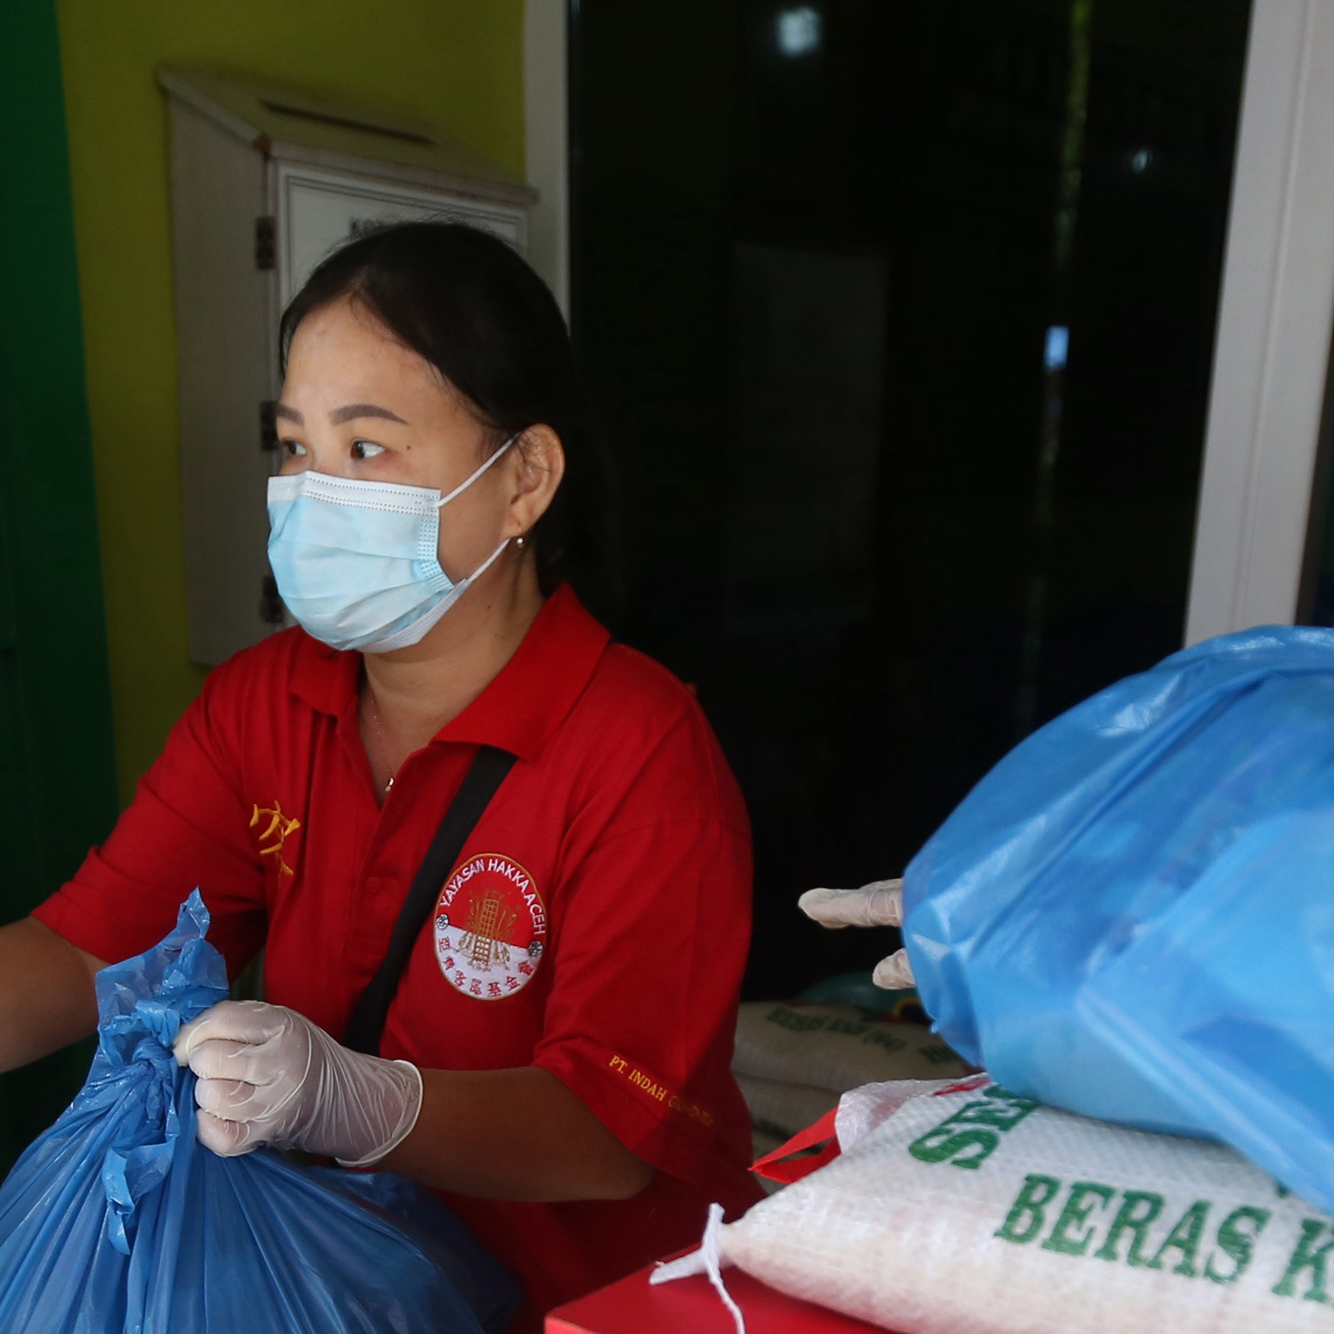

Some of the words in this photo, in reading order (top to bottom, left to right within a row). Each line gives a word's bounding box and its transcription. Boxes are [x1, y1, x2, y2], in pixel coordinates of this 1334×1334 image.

[439, 858, 485, 907] YAYASAN
[487, 858, 530, 893] HAKKA
[523, 893, 546, 935] ACEH
[628, 1069, 668, 1101] INDAH
[993, 1172, 1272, 1285] BERAS
